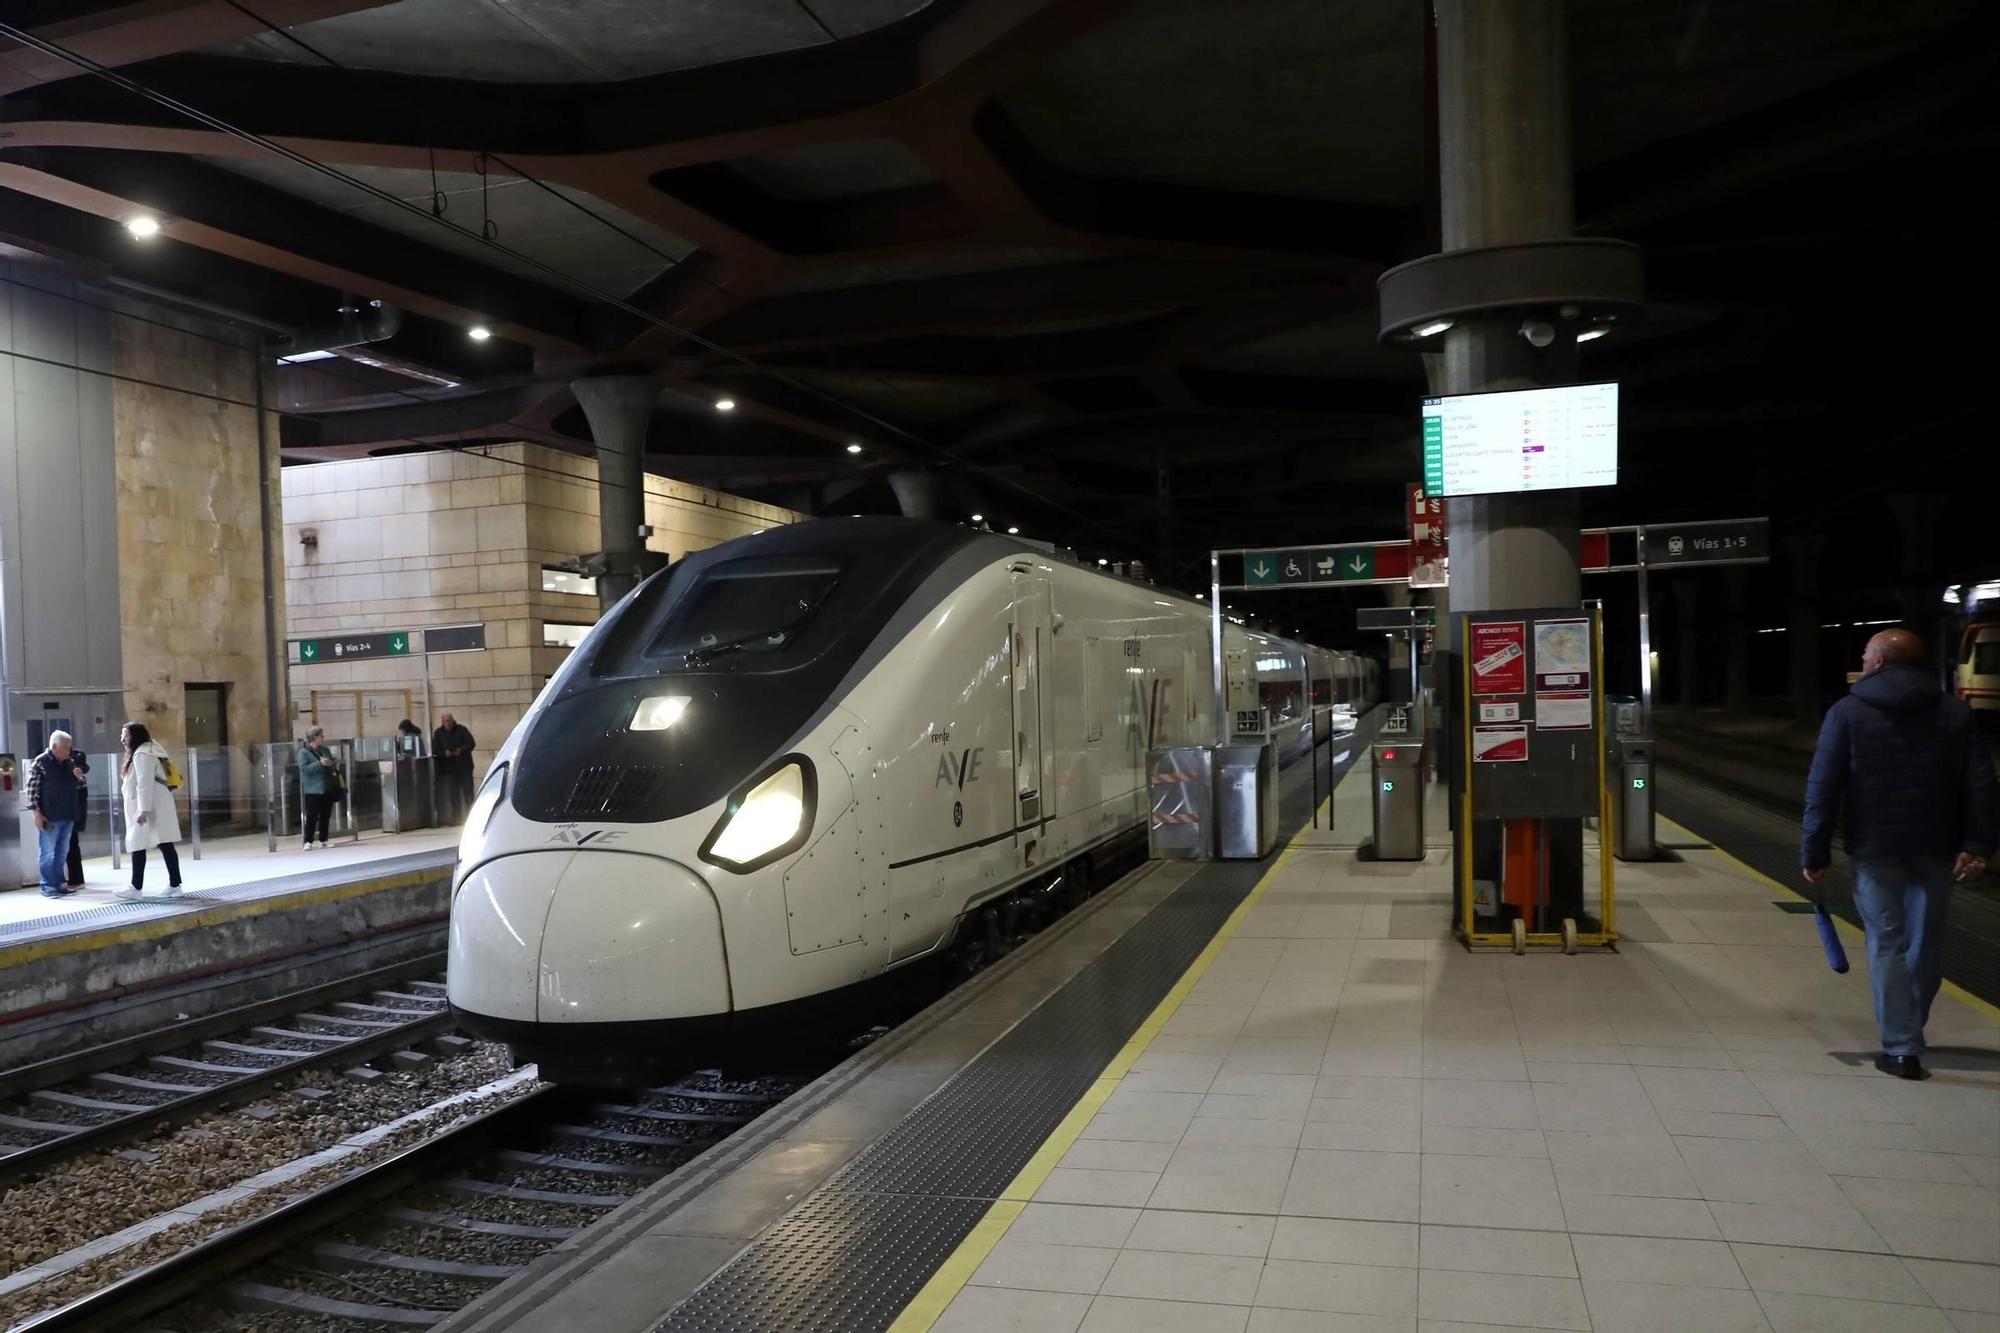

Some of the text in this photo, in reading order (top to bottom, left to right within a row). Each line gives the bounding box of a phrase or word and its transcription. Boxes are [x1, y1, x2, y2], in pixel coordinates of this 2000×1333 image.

[1693, 538, 1719, 550] Vías
[1123, 635, 1141, 660] renfe
[1126, 678, 1172, 753] AVE
[931, 728, 950, 746] renfe
[936, 747, 984, 793] AVE
[544, 830, 629, 846] AVE
